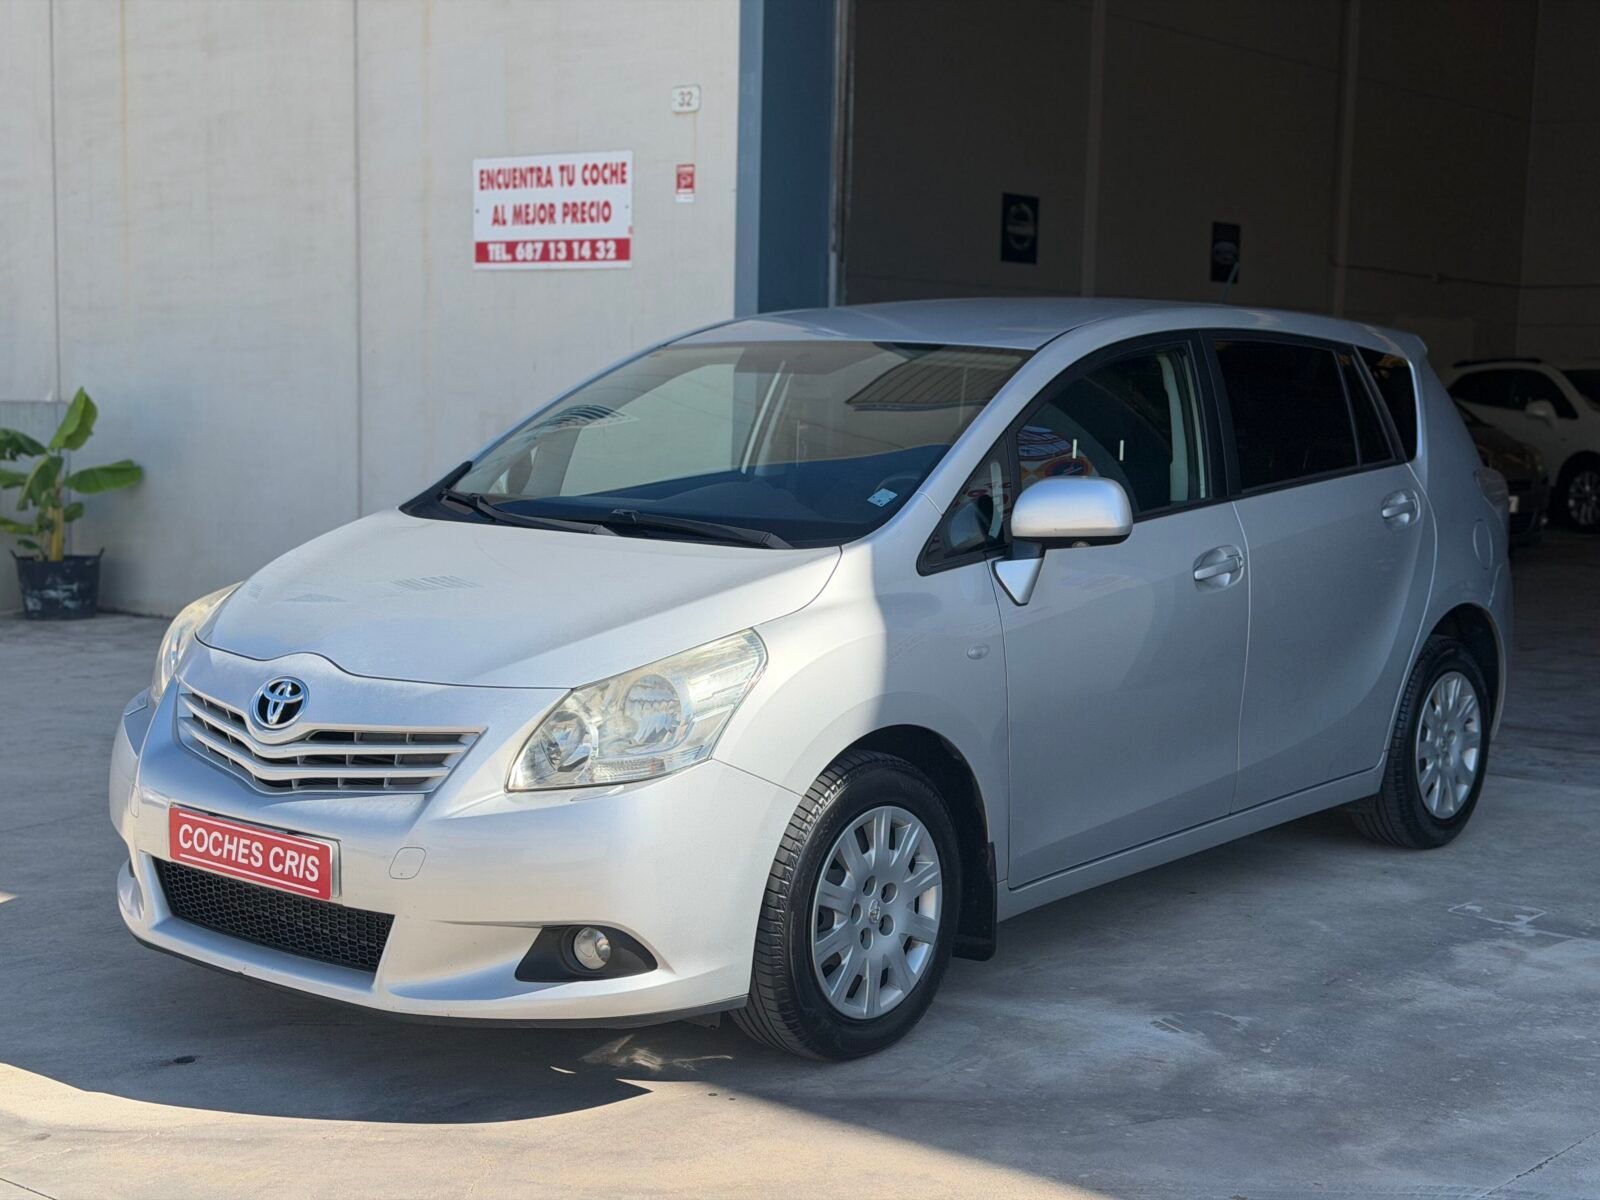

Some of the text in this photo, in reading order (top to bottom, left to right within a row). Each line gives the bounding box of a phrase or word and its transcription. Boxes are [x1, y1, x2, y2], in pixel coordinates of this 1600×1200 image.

[678, 91, 693, 107] 32
[479, 162, 627, 190] ENCUENTRA TU COCHE
[492, 201, 612, 226] AL MEJOR PRECIO
[487, 240, 617, 261] TEL. 687 13 14 32
[179, 824, 320, 881] COCHES CRIS
